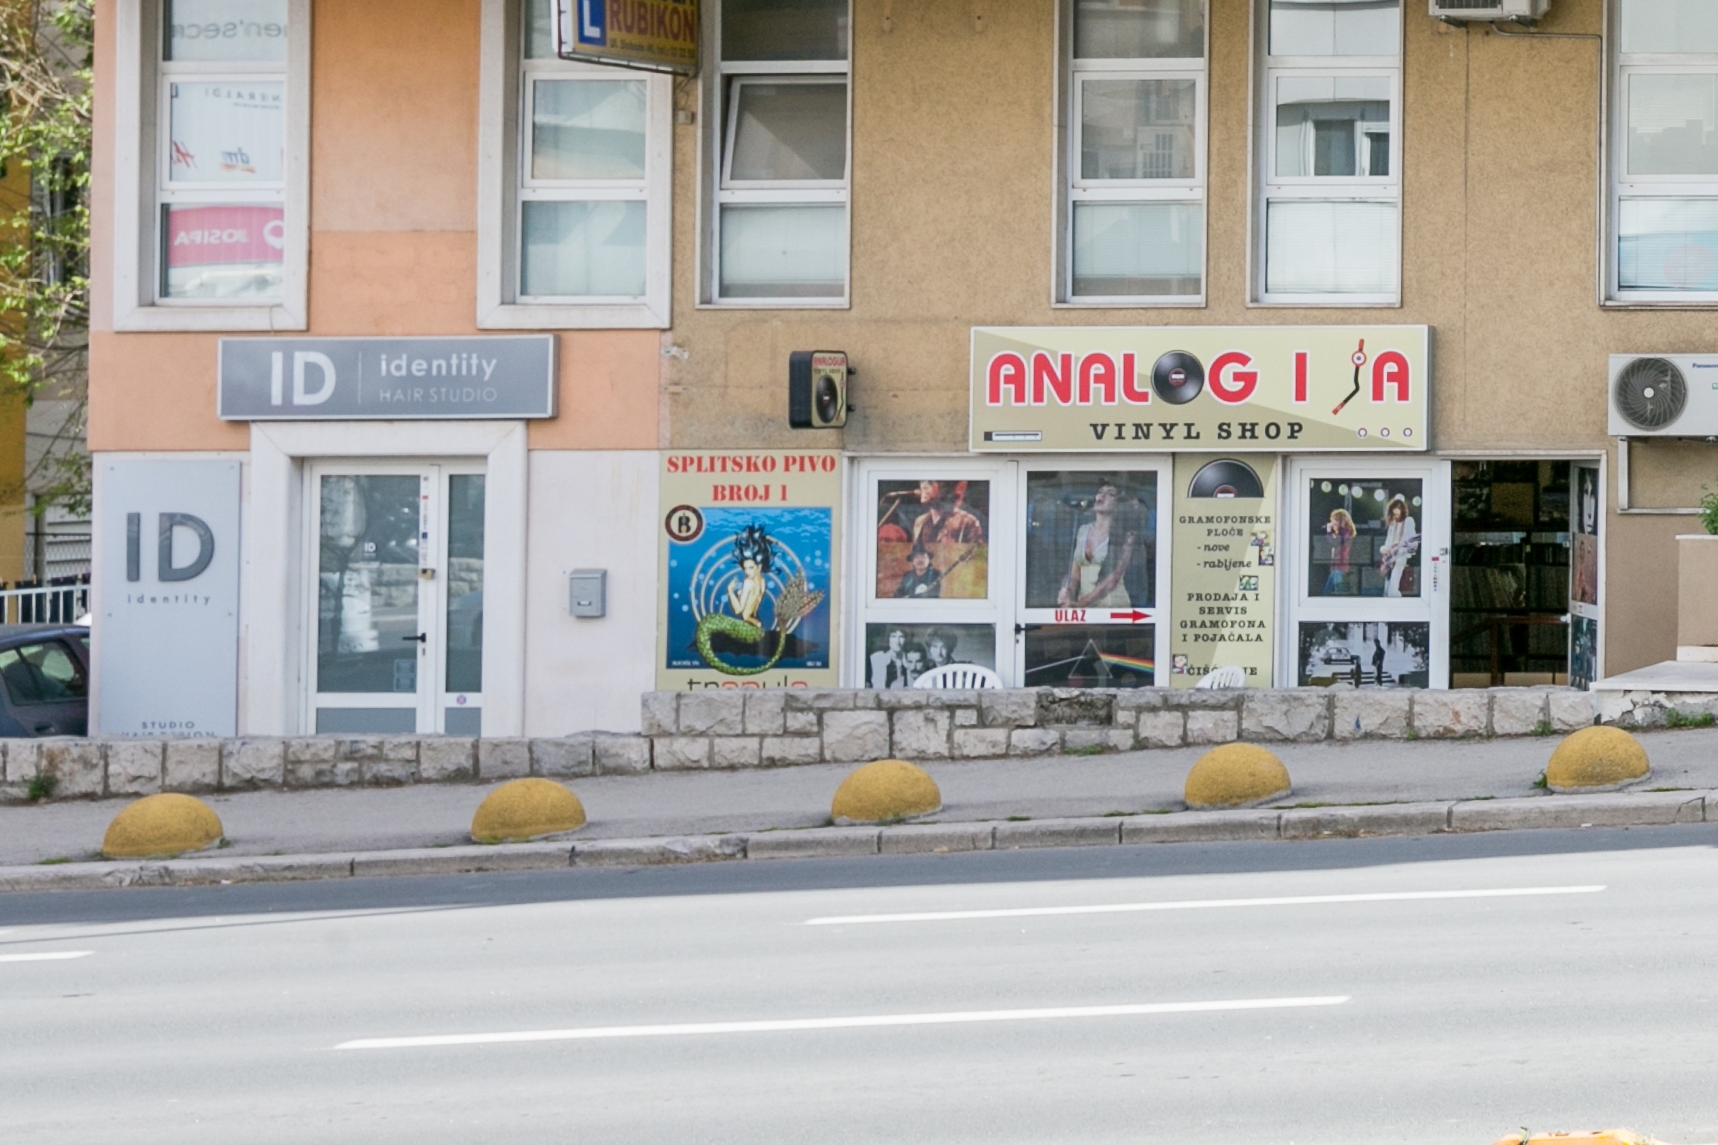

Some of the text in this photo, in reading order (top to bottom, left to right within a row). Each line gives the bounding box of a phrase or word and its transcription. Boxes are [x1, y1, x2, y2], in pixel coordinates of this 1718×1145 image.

[271, 351, 497, 405] ID identity
[379, 387, 497, 402] HAIR STUDIO
[1090, 422, 1304, 441] VINYL SHOP
[667, 455, 836, 473] SPLITSKO PIVO
[712, 484, 788, 501] BROJ 1
[1179, 516, 1271, 524] GRAMOFONSKE
[1206, 527, 1244, 537] PLOČE
[126, 512, 215, 582] ID
[1203, 544, 1230, 552] nove
[1203, 559, 1252, 571] rabljene
[127, 594, 211, 606] identity
[1187, 593, 1260, 602] PRODAJA I
[1054, 609, 1087, 622] ULAZ
[1199, 606, 1247, 615] SERVIS
[1180, 620, 1266, 629] GRAMOFONA
[1182, 631, 1263, 643] I POJAČALA
[141, 721, 196, 730] STUDIO
